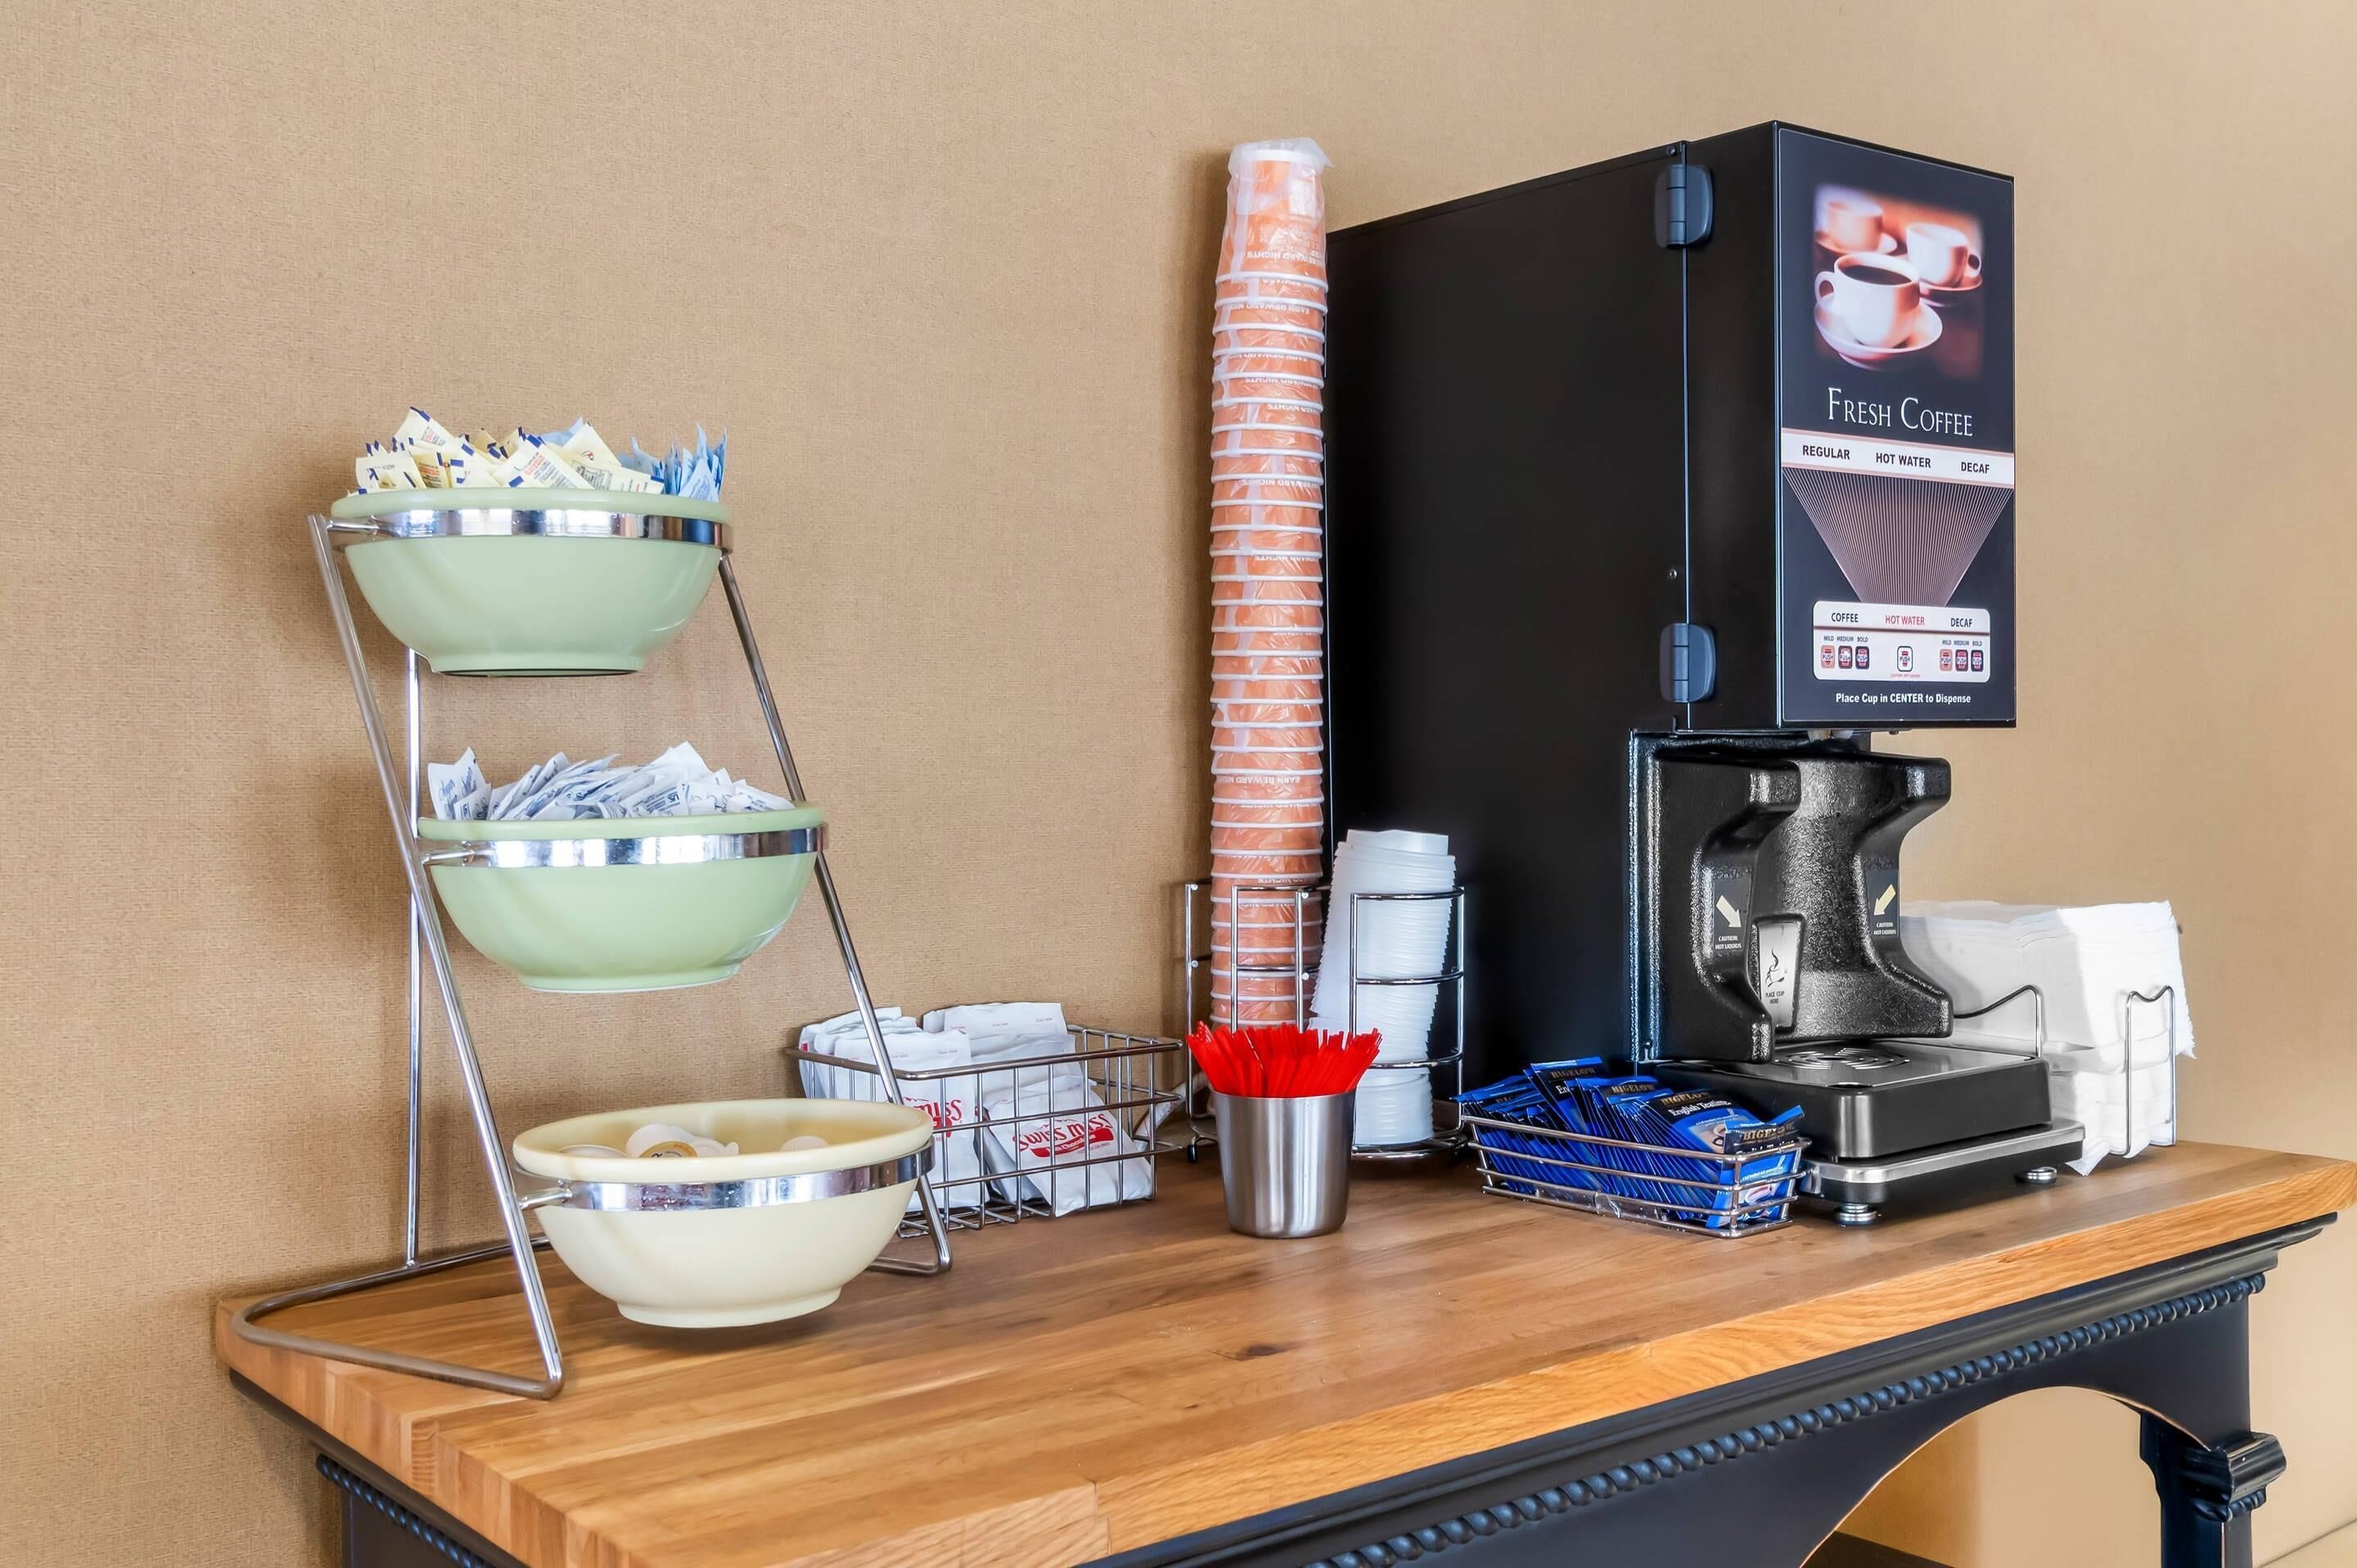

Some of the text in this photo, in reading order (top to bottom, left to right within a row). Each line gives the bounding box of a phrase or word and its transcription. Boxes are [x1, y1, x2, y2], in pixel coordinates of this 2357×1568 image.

[1802, 444, 1850, 460] REGULAR
[1876, 453, 1931, 468] HOT WATER
[1961, 462, 1990, 474] DECAF
[1831, 612, 1859, 623] COFFEE
[1885, 615, 1925, 626] HOT WATER
[1950, 617, 1973, 628] DECAF
[1836, 692, 1971, 705] Place Cup in CENTER to Dispense
[1236, 776, 1274, 784] REWARD
[1277, 776, 1301, 784] EARN
[1551, 1066, 1596, 1079] BIGELOW
[1611, 1084, 1655, 1094] BIGELOW
[1668, 1105, 1701, 1116] English
